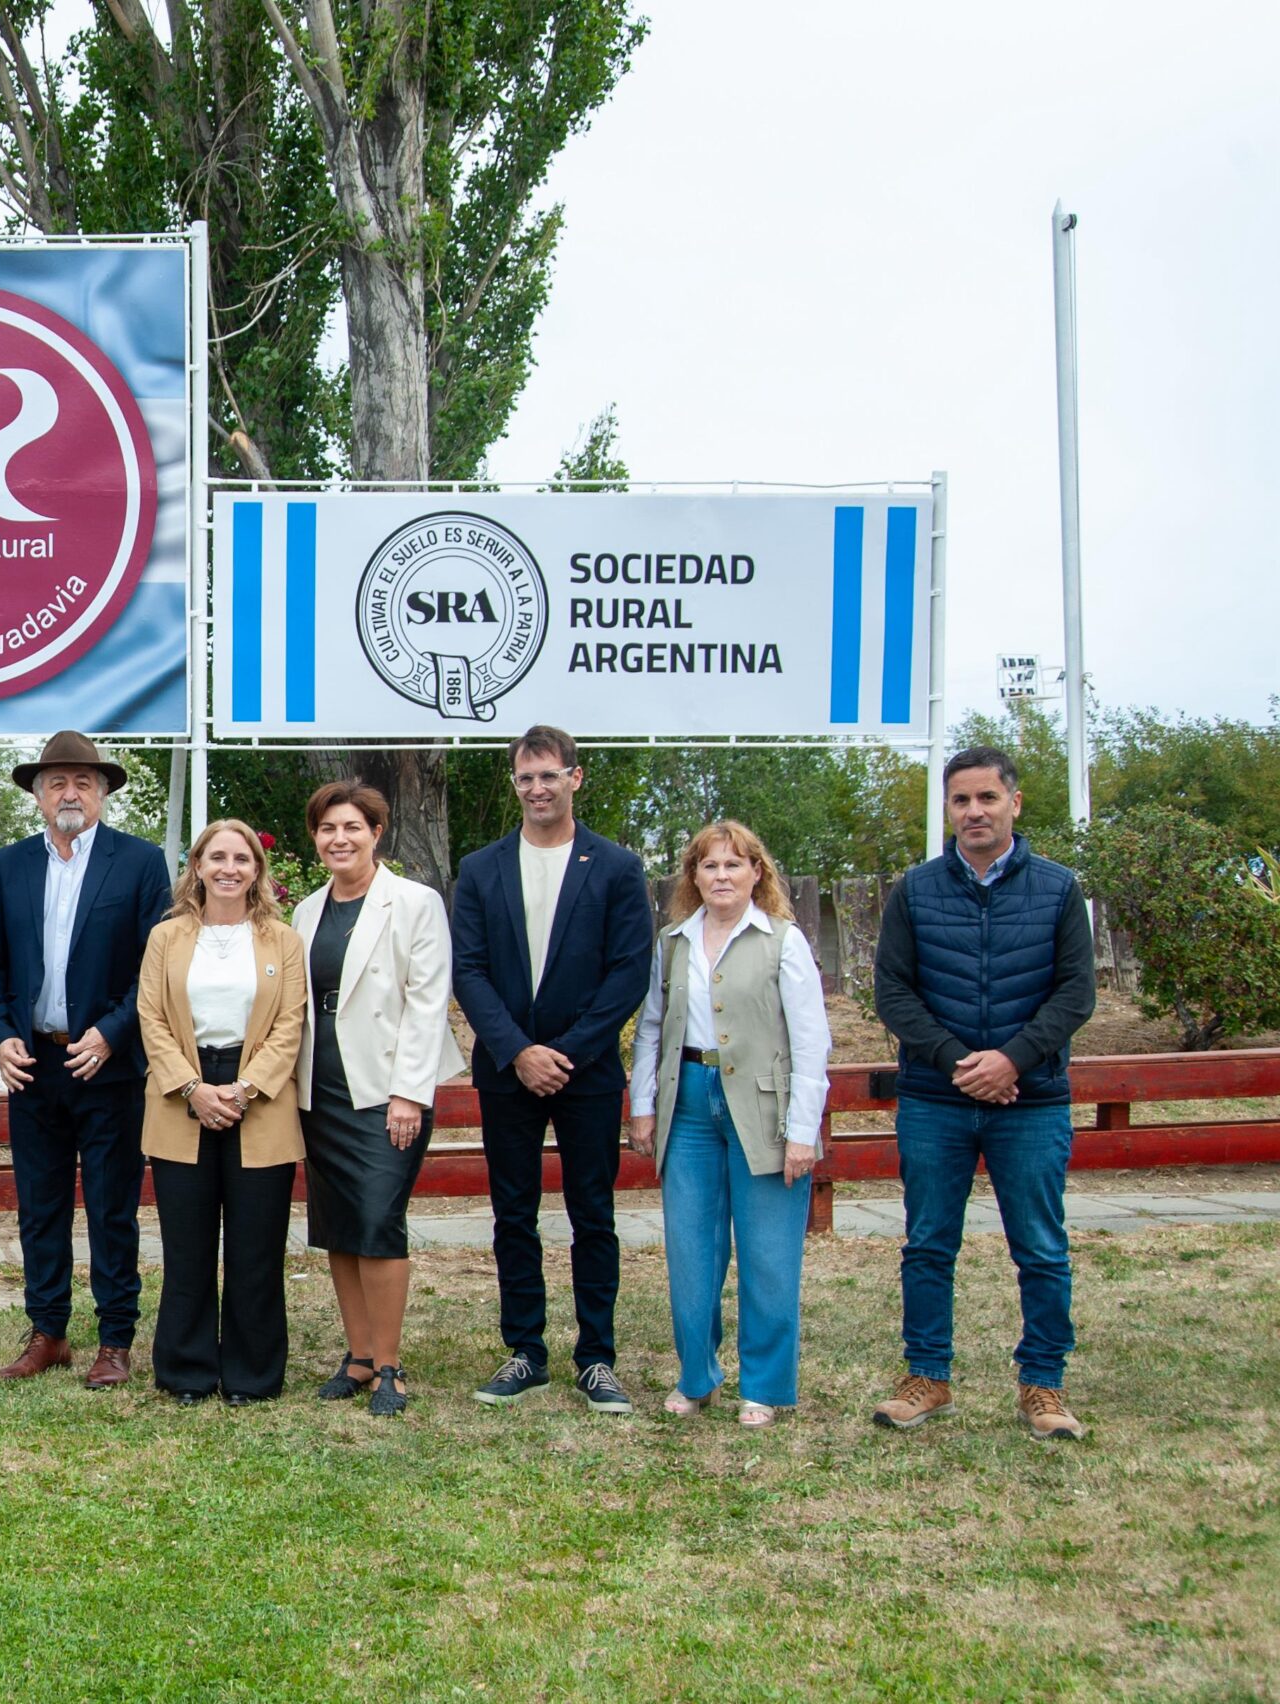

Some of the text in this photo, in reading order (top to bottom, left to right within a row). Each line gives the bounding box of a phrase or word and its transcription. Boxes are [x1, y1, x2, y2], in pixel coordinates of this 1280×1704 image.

[570, 553, 755, 584] SOCIEDAD
[371, 527, 533, 663] CULTIVAR EL SUELO ES SERVIR A LA PATRIA
[406, 588, 500, 625] SRA
[570, 598, 693, 628] RURAL
[568, 643, 783, 673] ARGENTINA
[446, 667, 462, 706] 1866
